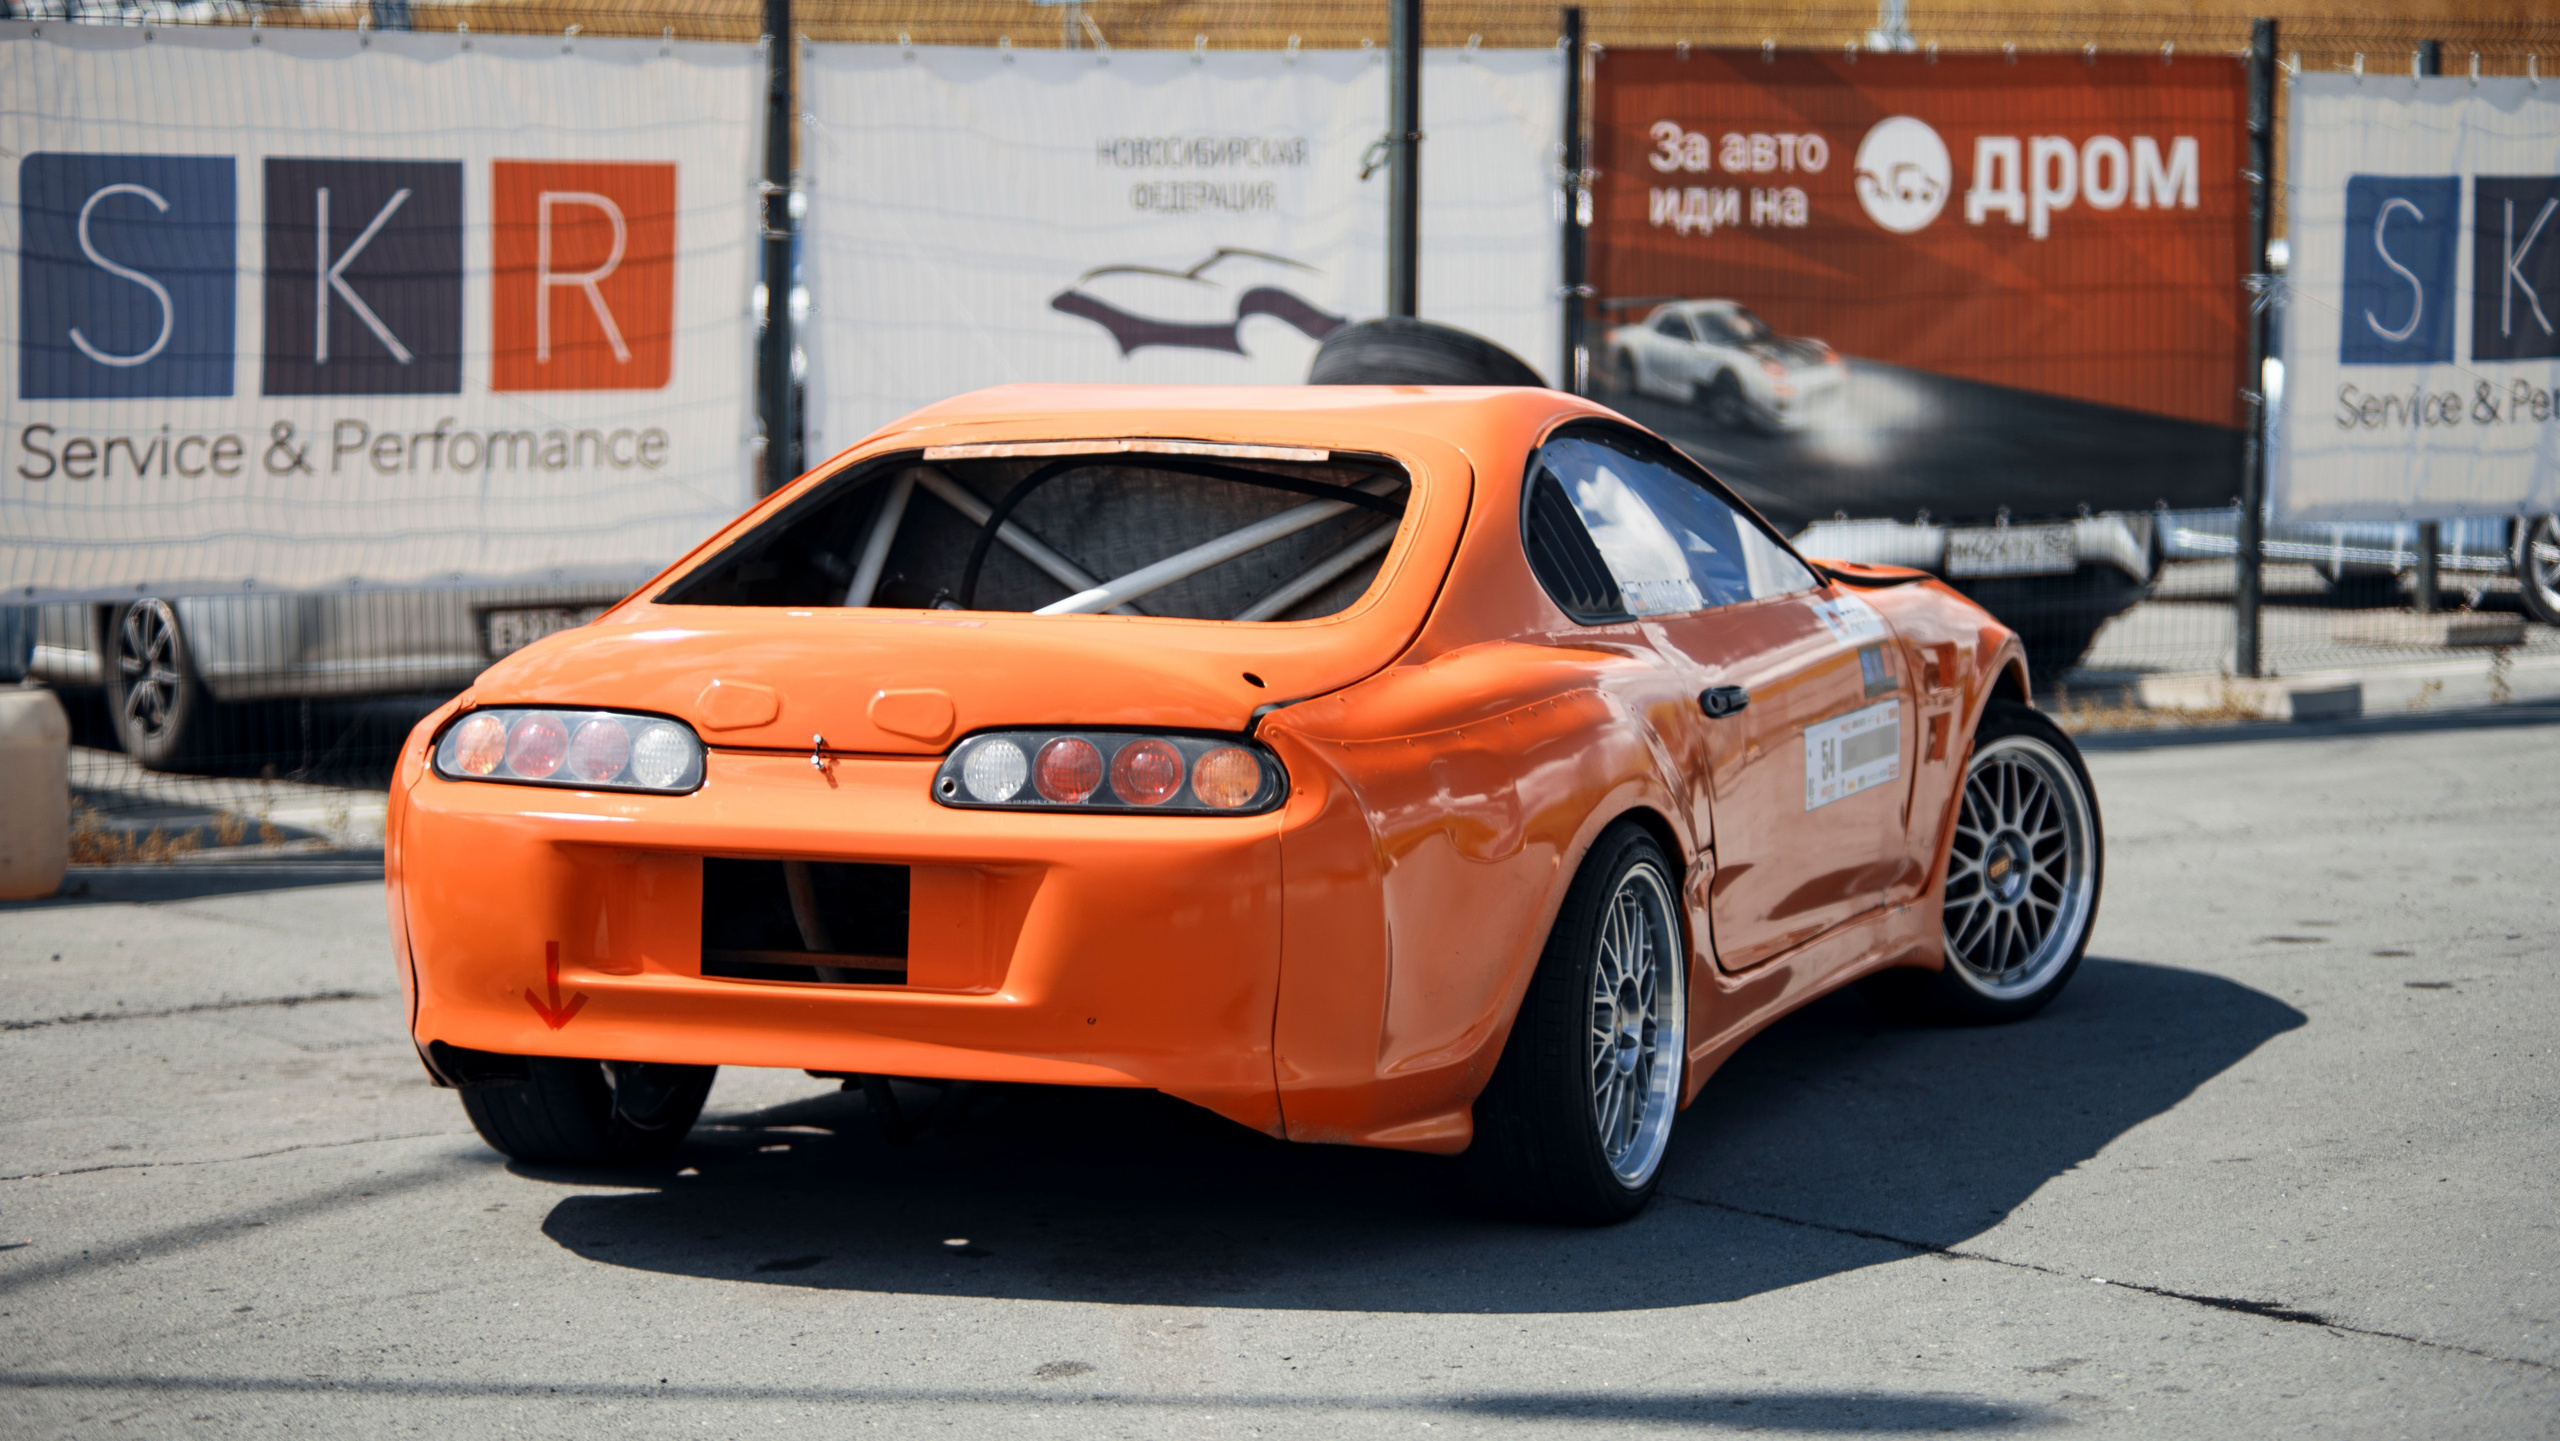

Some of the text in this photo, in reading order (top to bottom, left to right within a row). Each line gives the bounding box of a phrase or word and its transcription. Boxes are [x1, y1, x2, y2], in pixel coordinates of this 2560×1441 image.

[1096, 137, 1311, 168] НОВОСИБИРСКАЯ
[1649, 121, 1829, 173] За авто
[1131, 181, 1277, 213] ФЕДЕРАЦИЯ
[1649, 187, 1808, 236] иди на
[1964, 135, 2199, 241] дром
[69, 183, 632, 366] SKR
[2335, 382, 2462, 430] Service
[2472, 378, 2502, 424] &
[17, 416, 669, 481] Service & Perfomance
